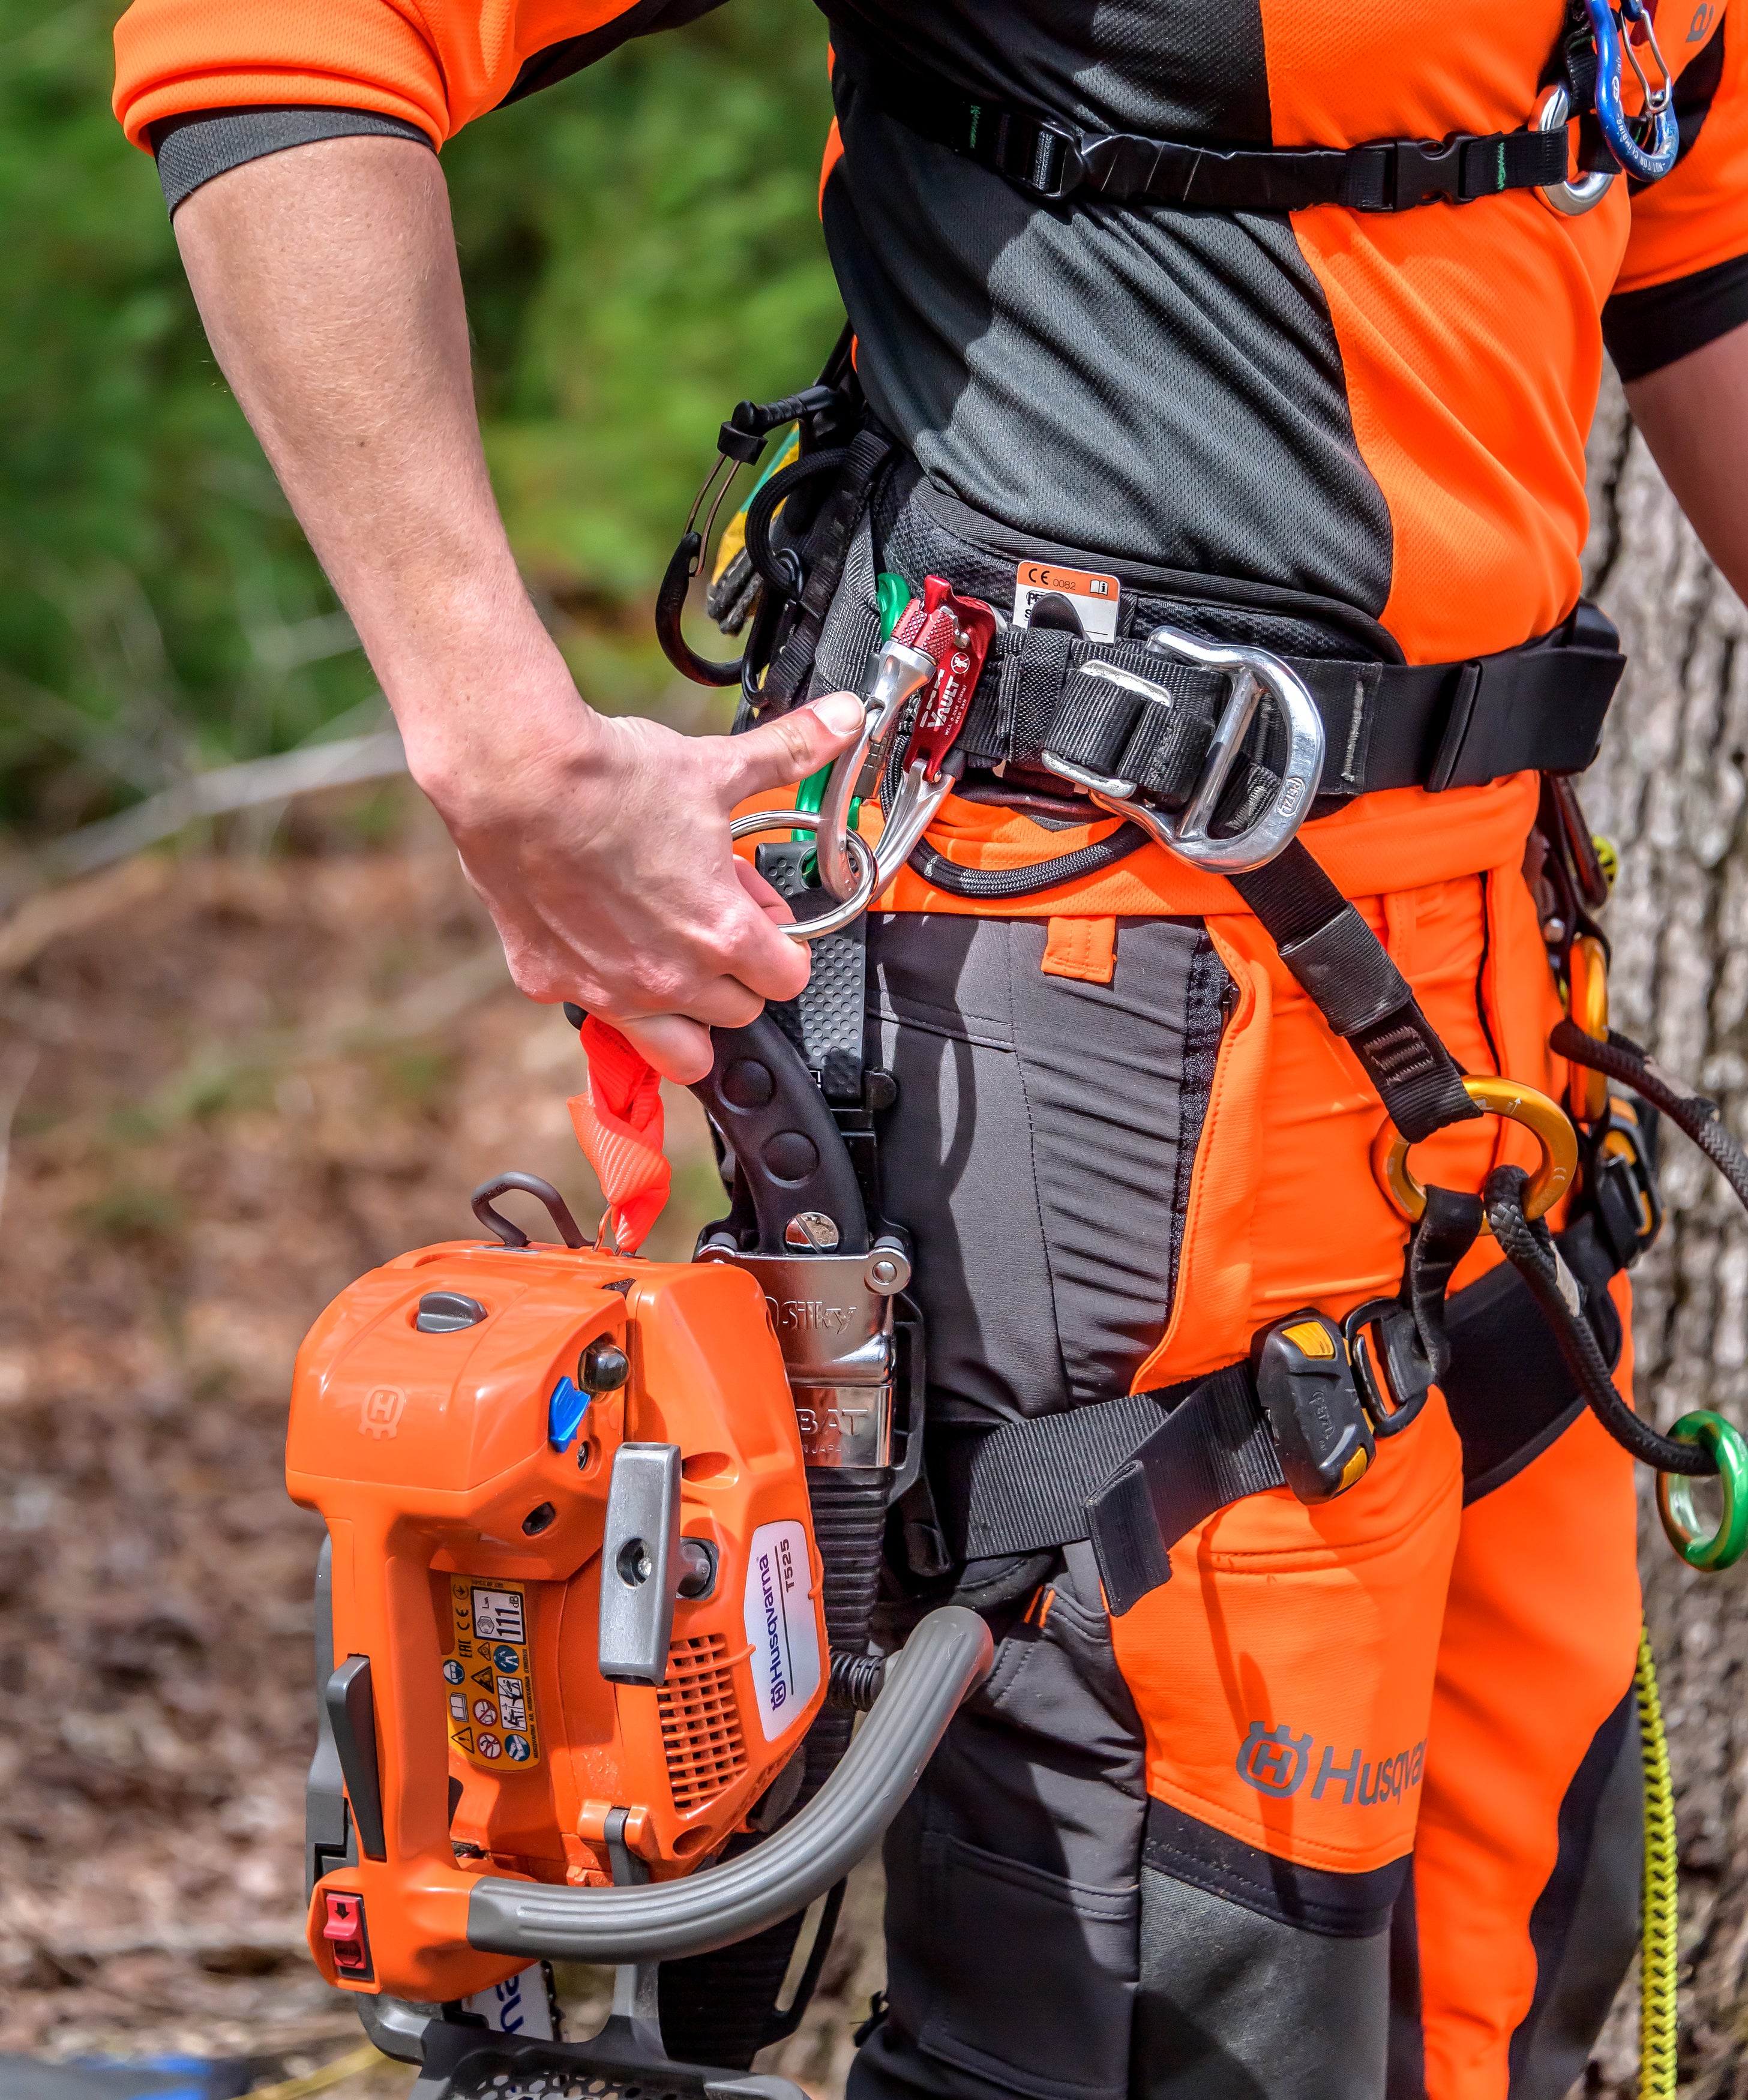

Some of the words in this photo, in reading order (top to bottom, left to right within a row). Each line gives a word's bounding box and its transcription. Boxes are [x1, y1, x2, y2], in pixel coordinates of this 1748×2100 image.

[1053, 578, 1077, 590] 0082
[927, 675, 960, 728] VAULT
[1281, 778, 1303, 813] PETZL
[782, 1300, 857, 1335] Silky
[796, 1408, 868, 1436] BAT
[779, 1538, 794, 1594] T525
[509, 1595, 519, 1609] dB
[758, 1553, 782, 1685] Husqvarna
[494, 1607, 521, 1637] 111
[524, 1676, 533, 1711] HUSKVARNA
[1311, 1738, 1428, 1806] Husqva
